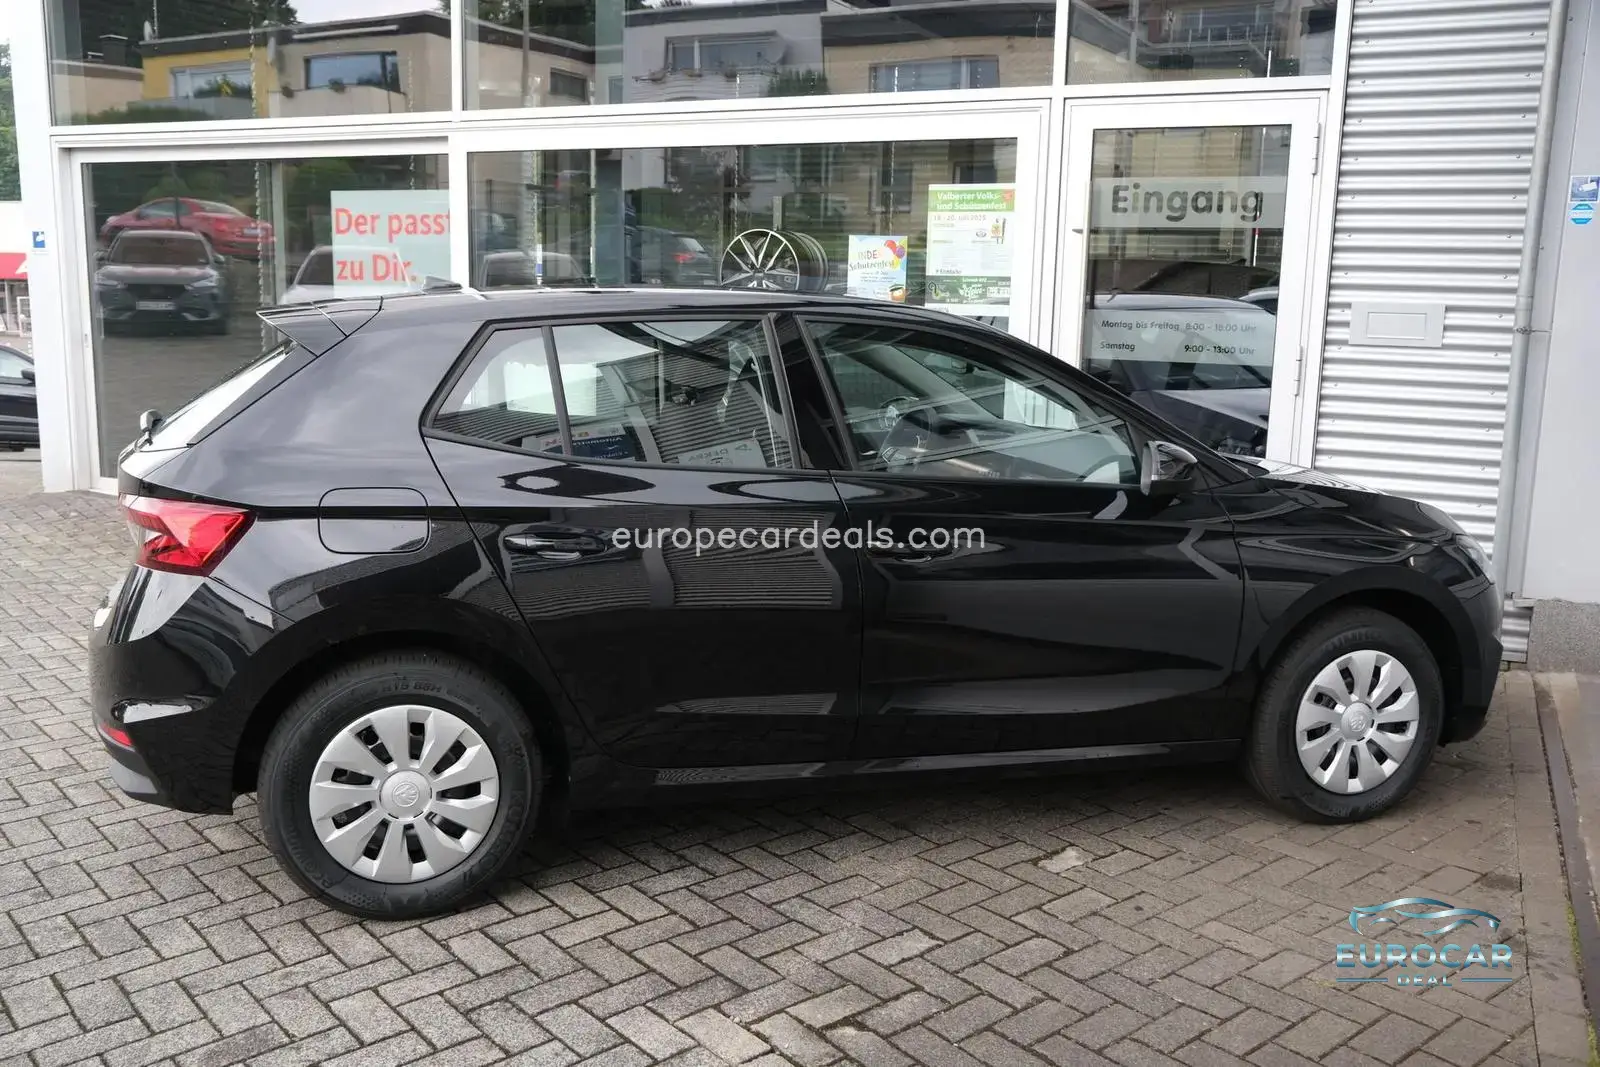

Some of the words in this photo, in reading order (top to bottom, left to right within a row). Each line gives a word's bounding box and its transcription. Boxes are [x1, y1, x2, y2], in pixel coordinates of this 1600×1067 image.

[1112, 182, 1263, 222] Eingang
[335, 208, 380, 235] Der
[336, 260, 364, 281] zu
[372, 252, 416, 282] Dir.
[1101, 320, 1133, 331] Montag
[1136, 321, 1149, 329] bis
[1151, 321, 1180, 331] Freitag
[1100, 341, 1136, 352] Samstag
[1184, 344, 1204, 353] 9:00
[1213, 345, 1236, 355] 13:00
